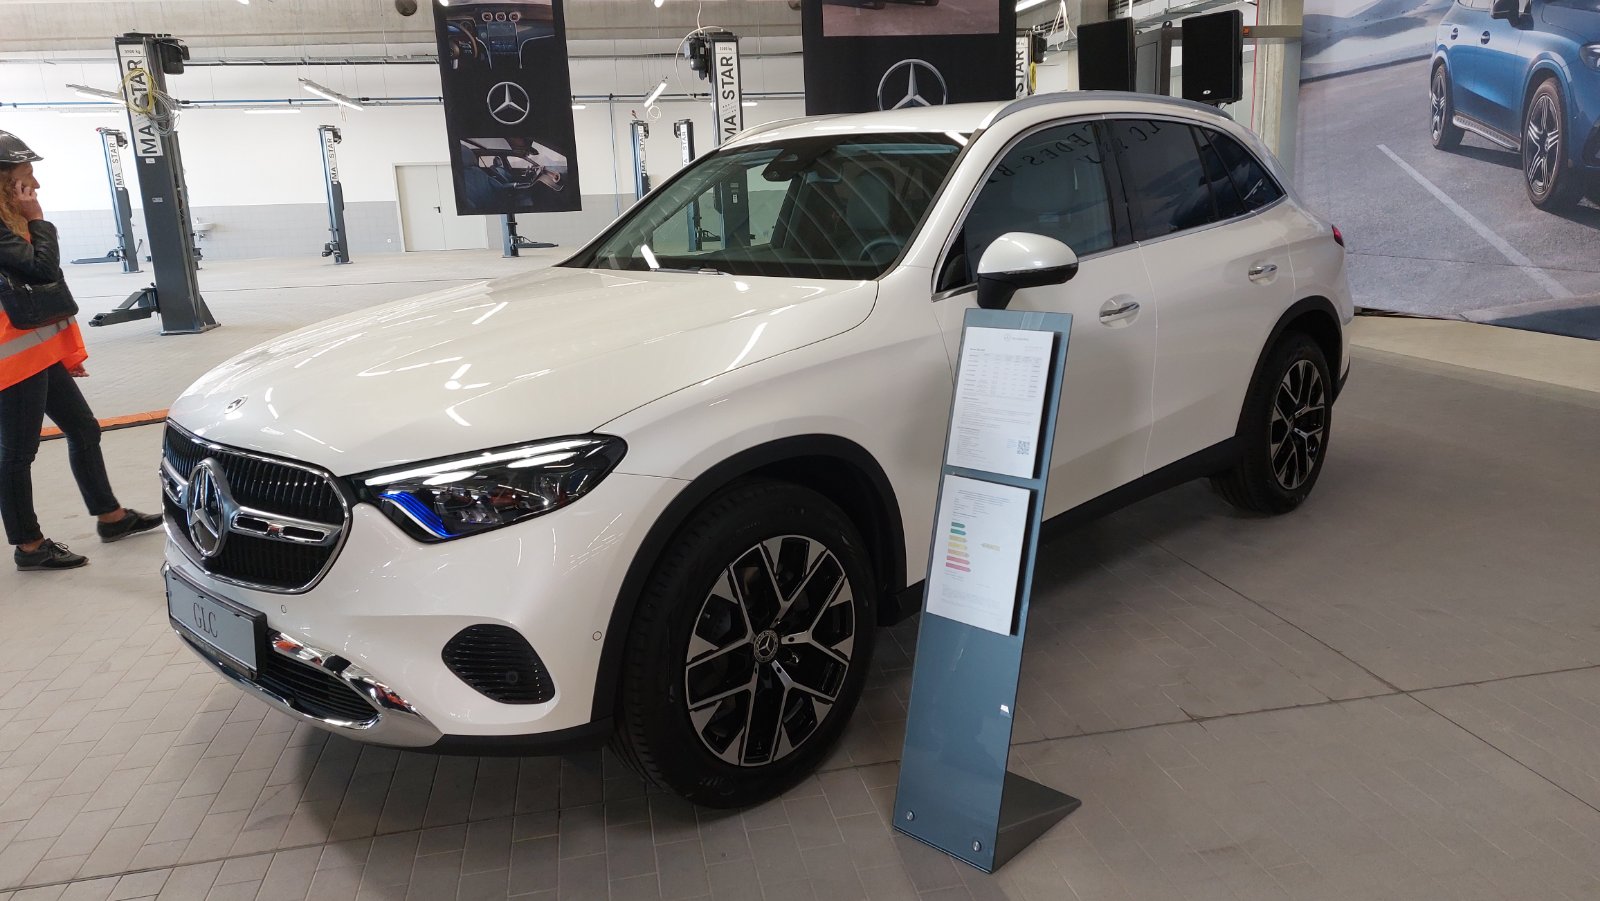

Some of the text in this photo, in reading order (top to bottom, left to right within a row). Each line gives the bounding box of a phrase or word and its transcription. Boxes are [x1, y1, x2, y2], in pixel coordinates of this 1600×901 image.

[720, 56, 735, 100] STAR
[139, 125, 157, 154] MA
[109, 142, 122, 185] MA STAR
[331, 167, 337, 179] MA
[193, 602, 218, 638] GLC
